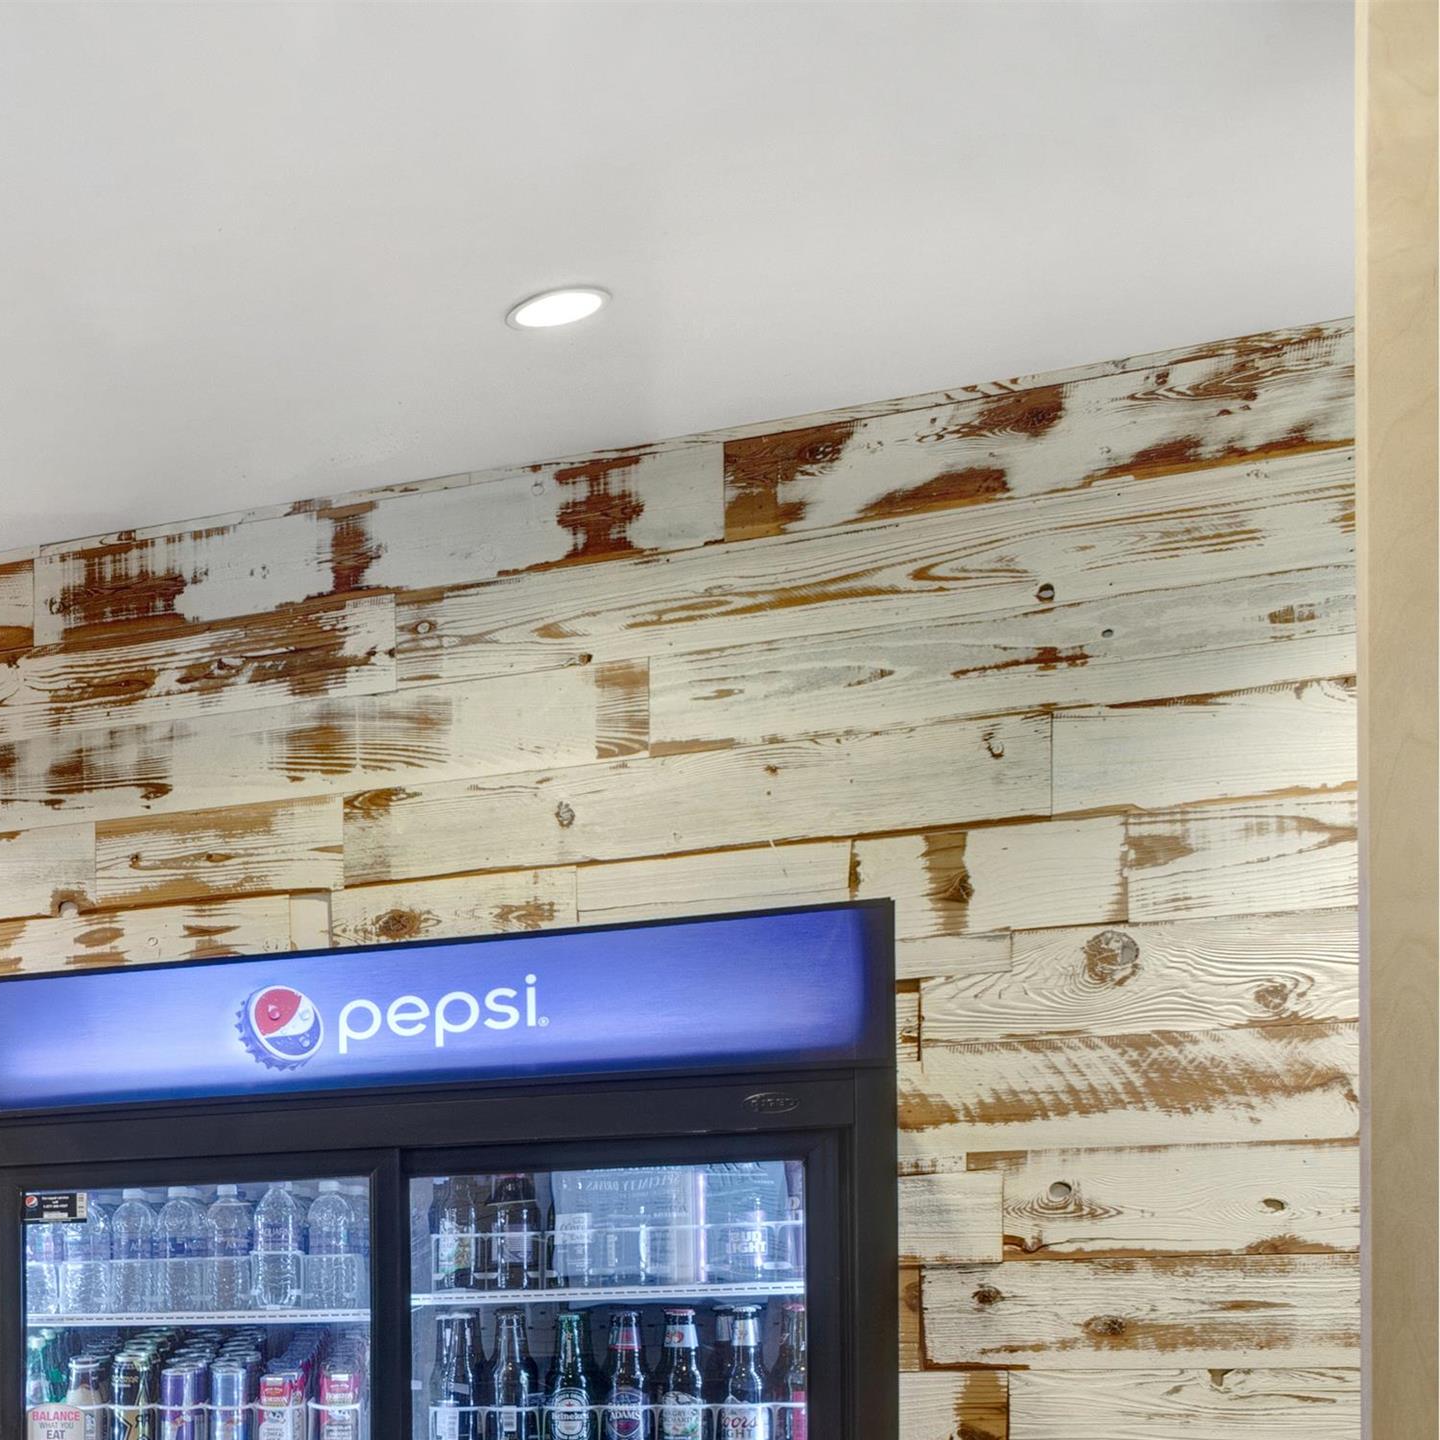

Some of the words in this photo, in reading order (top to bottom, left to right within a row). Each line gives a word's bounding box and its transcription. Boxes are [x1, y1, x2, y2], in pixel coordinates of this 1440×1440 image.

[339, 974, 537, 1054] pepsi
[32, 1411, 80, 1421] BALANCE
[46, 1430, 65, 1440] EAT
